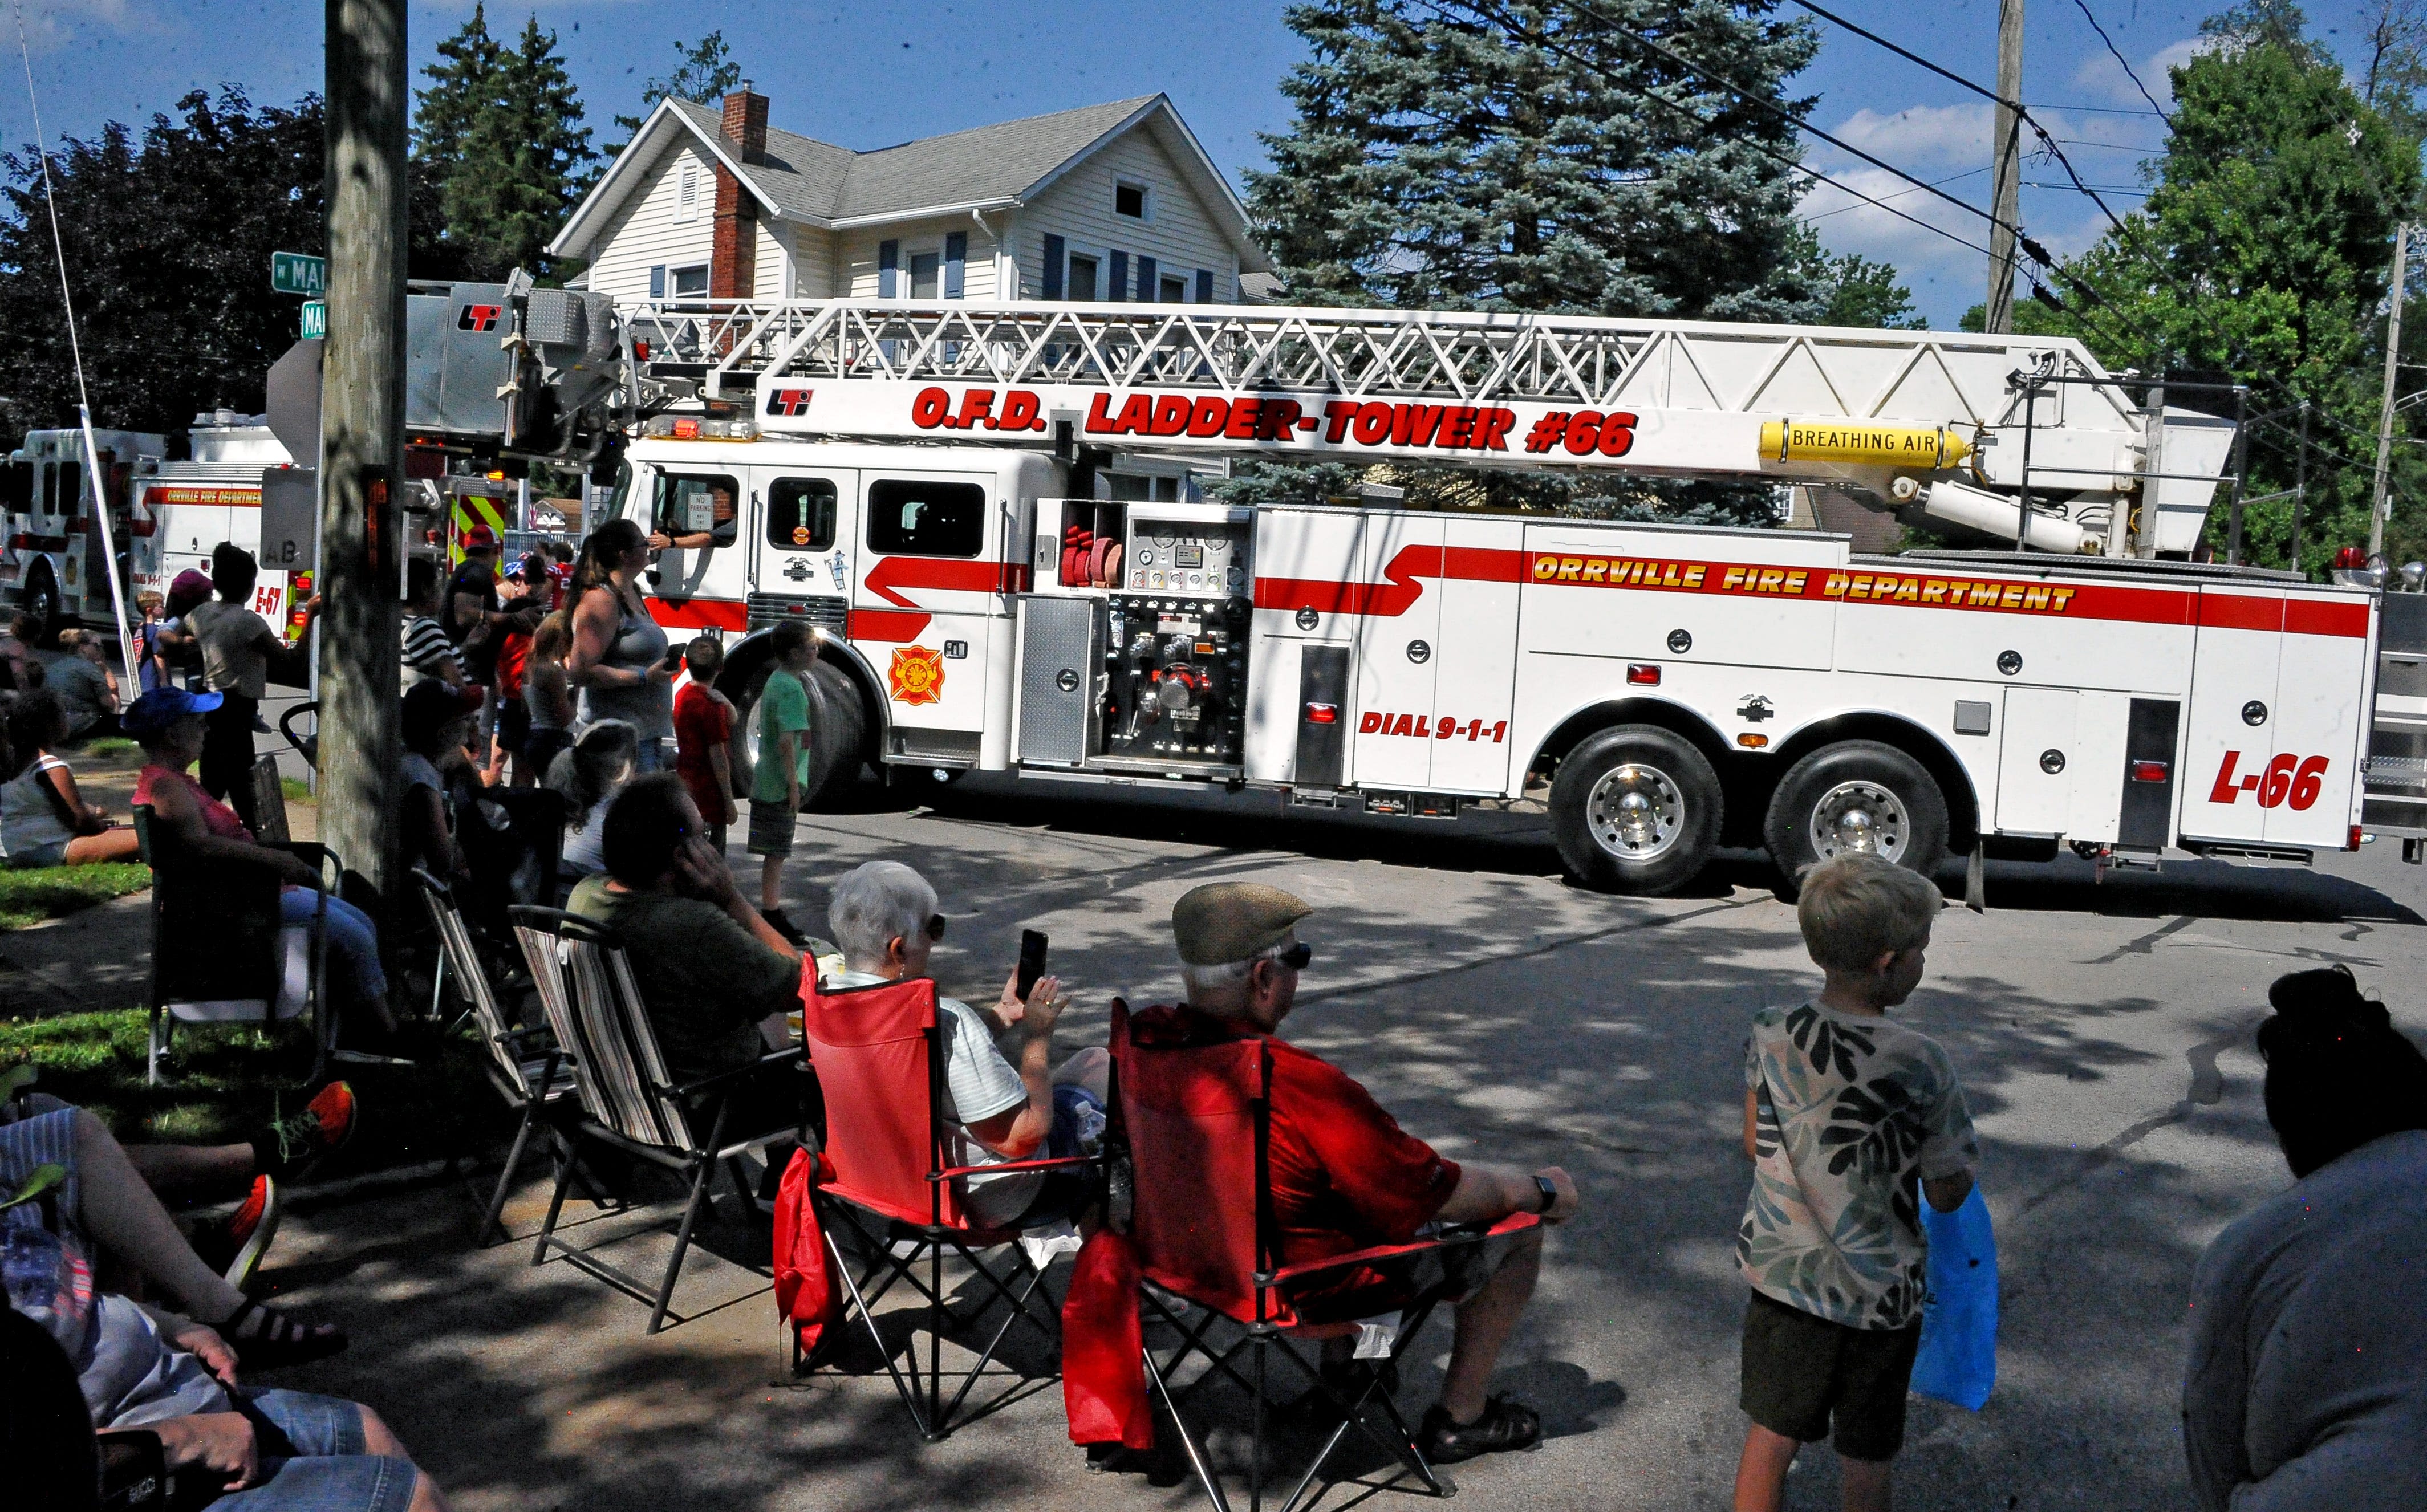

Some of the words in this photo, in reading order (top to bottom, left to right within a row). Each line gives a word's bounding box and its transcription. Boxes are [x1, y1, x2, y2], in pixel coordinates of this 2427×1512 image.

[277, 265, 285, 278] W
[293, 260, 325, 290] MAI
[305, 306, 325, 334] MAI
[912, 387, 1047, 432] O.F.D.
[1085, 392, 1516, 452] LADDER-TOWER
[1525, 410, 1639, 458] #66
[1793, 430, 1894, 450] BREATHING
[1904, 436, 1934, 452] AIR
[218, 491, 262, 505] DEPARTMEN
[1535, 556, 1708, 588] ORRVILLE
[1722, 568, 1808, 594] FIRE
[1824, 573, 2075, 612] DEPARTMENT
[255, 586, 282, 615] E-67
[1359, 712, 1430, 738] DIAL
[1435, 716, 1508, 743] 9-1-1
[2208, 750, 2330, 811] L-66
